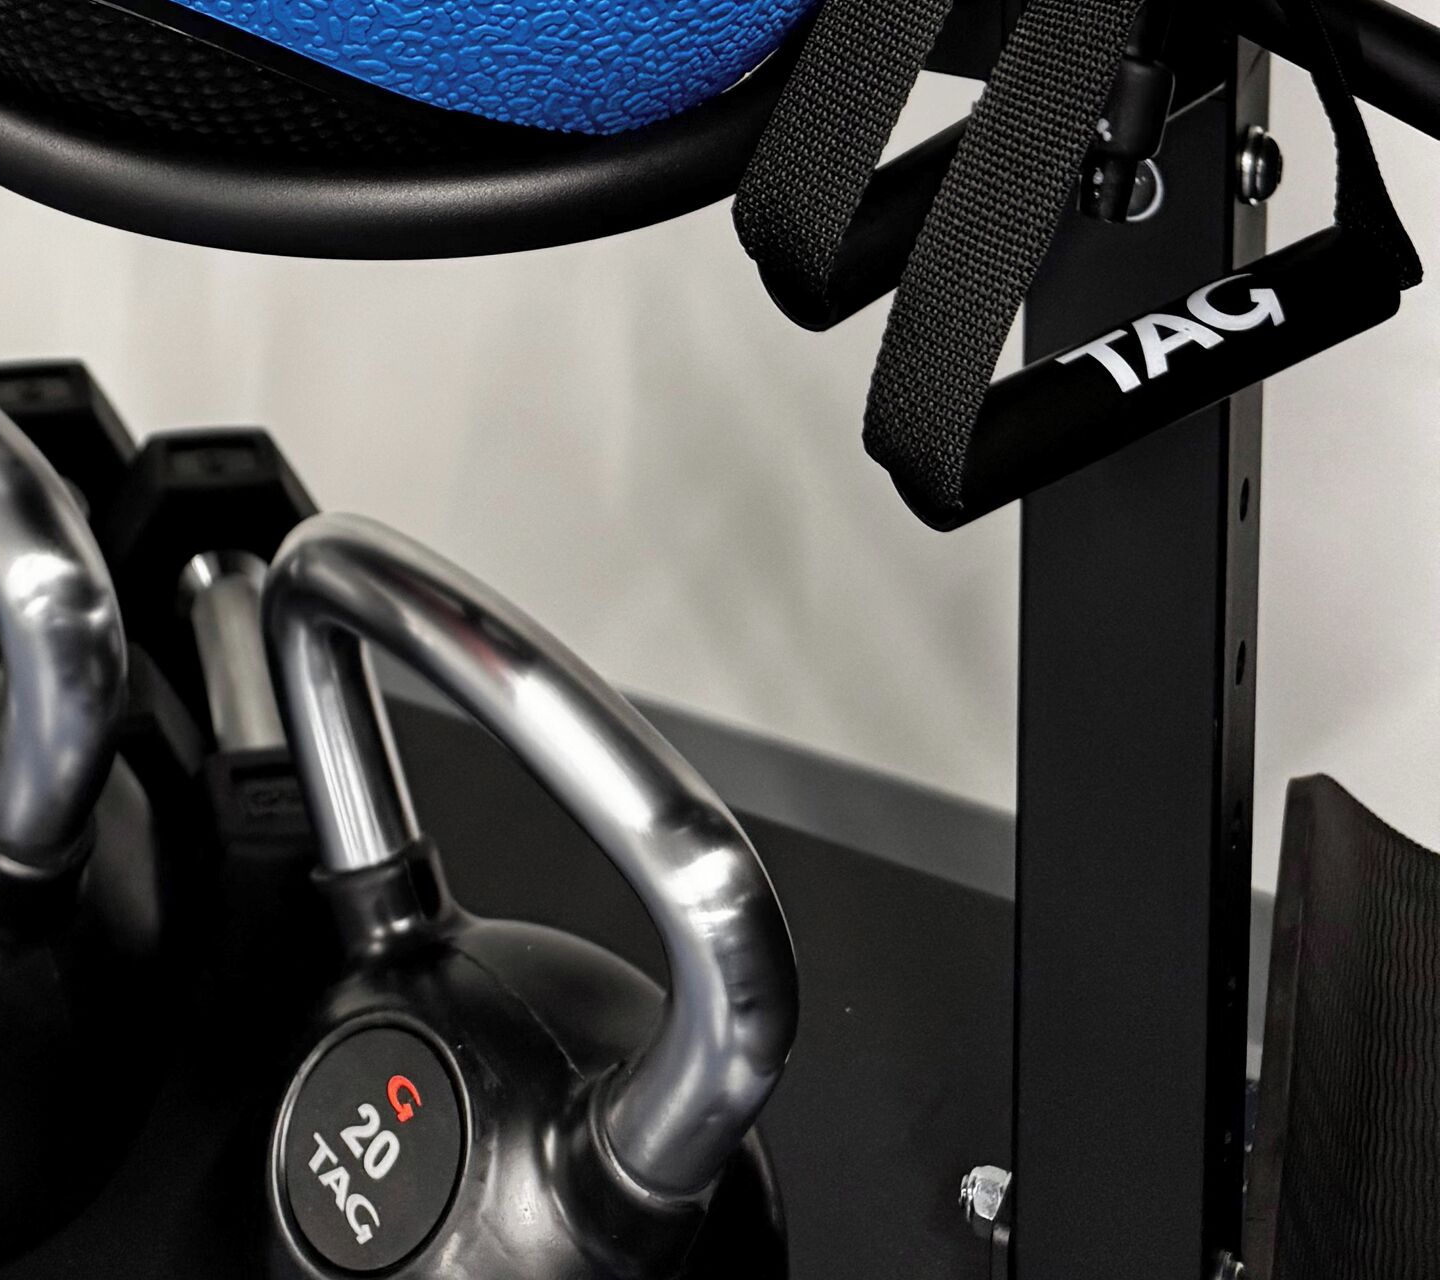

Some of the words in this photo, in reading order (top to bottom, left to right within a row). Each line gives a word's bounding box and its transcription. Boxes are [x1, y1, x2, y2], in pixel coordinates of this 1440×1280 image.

[1054, 272, 1286, 393] TAG
[308, 1131, 381, 1245] TAG
[339, 1103, 401, 1180] 20
